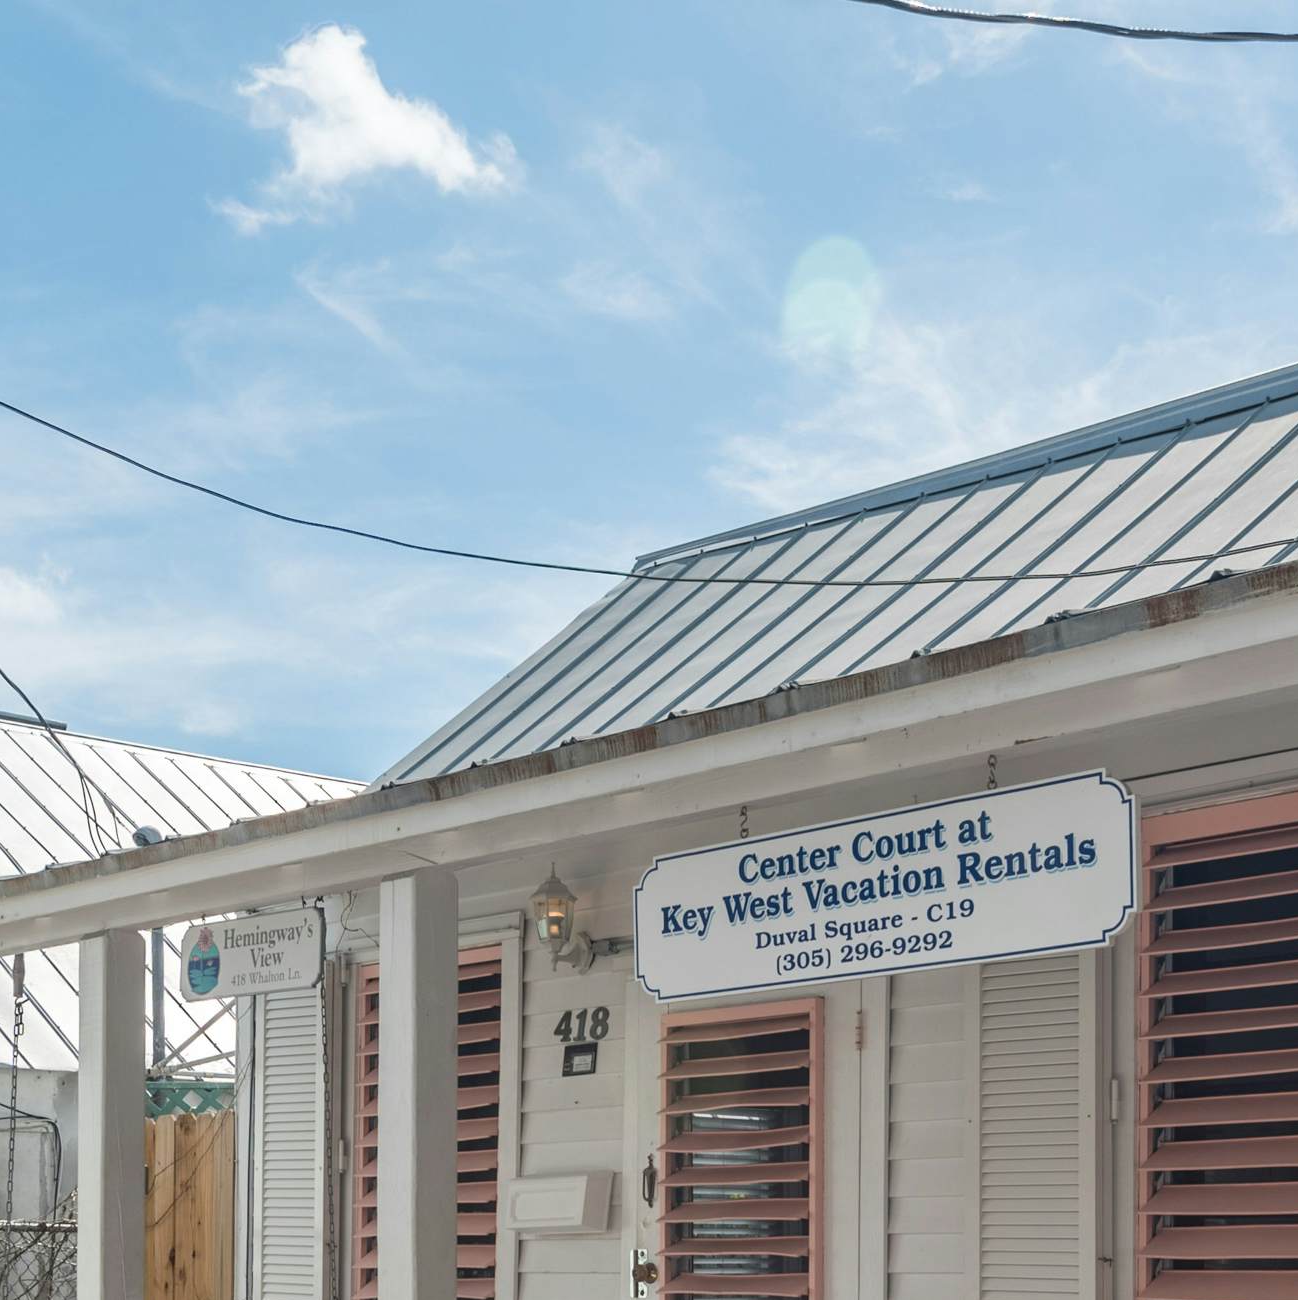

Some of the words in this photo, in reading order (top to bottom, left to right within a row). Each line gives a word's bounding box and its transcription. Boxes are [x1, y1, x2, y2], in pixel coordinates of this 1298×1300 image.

[739, 845, 842, 884] Center
[852, 820, 946, 863] Court
[958, 810, 992, 845] at
[661, 904, 714, 938] Key
[722, 887, 794, 924] West
[802, 864, 945, 910] Vacation
[957, 833, 1097, 886] Rentals
[223, 917, 314, 950] Hemingway's
[755, 924, 817, 950] Duval
[824, 912, 904, 941] Square
[926, 898, 975, 923] C19
[250, 947, 285, 969] View
[776, 948, 832, 976] (305)
[840, 930, 953, 963] 296-9292
[230, 973, 246, 987] 418
[249, 969, 285, 985] Whalton
[288, 967, 302, 981] Ln.
[553, 1006, 610, 1043] 418
